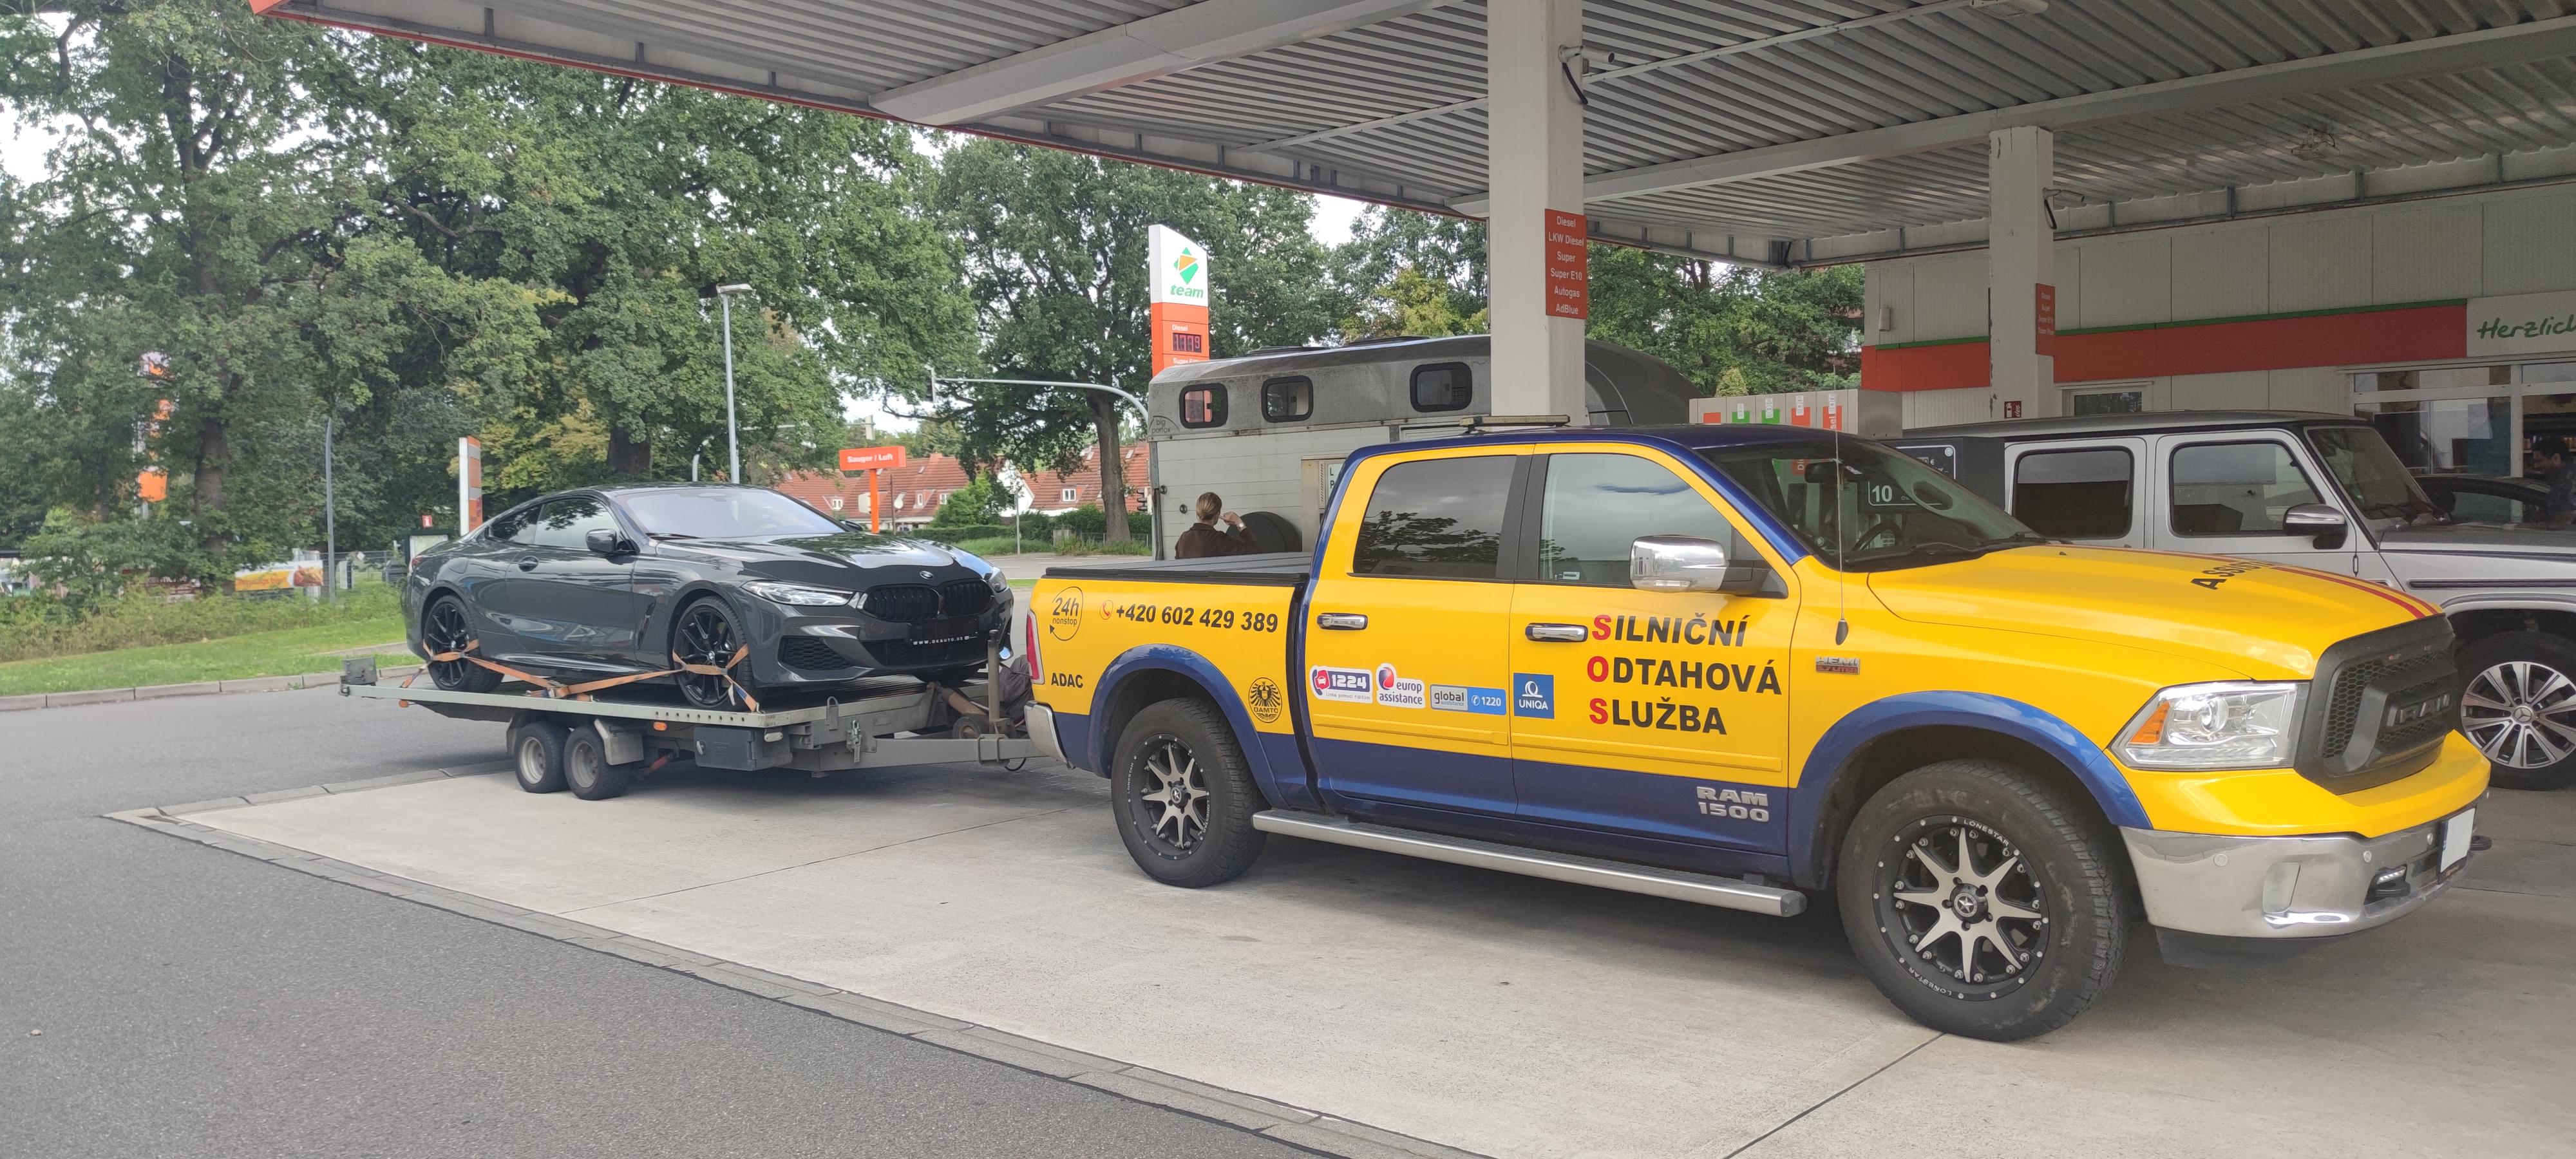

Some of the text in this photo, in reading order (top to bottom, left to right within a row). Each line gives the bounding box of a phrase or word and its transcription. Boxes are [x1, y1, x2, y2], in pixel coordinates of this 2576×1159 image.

[1557, 216, 1576, 227] Diesel
[1548, 232, 1584, 247] LKW Diesel
[1557, 251, 1576, 263] Super
[1551, 268, 1582, 281] Super E10
[1170, 285, 1204, 298] team
[1554, 285, 1580, 299] Autogas
[1556, 303, 1578, 315] AdBlue
[1871, 485, 1893, 502] 10
[1052, 597, 1079, 617] 24h
[1052, 617, 1077, 628] nonstop
[1116, 603, 1278, 633] +420 602 429 389
[1591, 612, 1751, 647] SILNIČNÍ
[1051, 673, 1083, 688] ADAC
[1332, 674, 1367, 689] 1224
[1587, 655, 1783, 695] ODTAHOVÁ
[1396, 681, 1422, 694] europ
[1379, 691, 1423, 704] assistance
[1434, 691, 1464, 704] global
[1481, 696, 1502, 707] 1220
[1519, 699, 1549, 711] UNIQA
[1589, 696, 1727, 735] SLUŽBA
[1696, 786, 1769, 807] RAM
[1698, 802, 1770, 822] 1500
[1964, 819, 2009, 847] LONESTAR
[1908, 966, 1952, 996] LONESTAR
